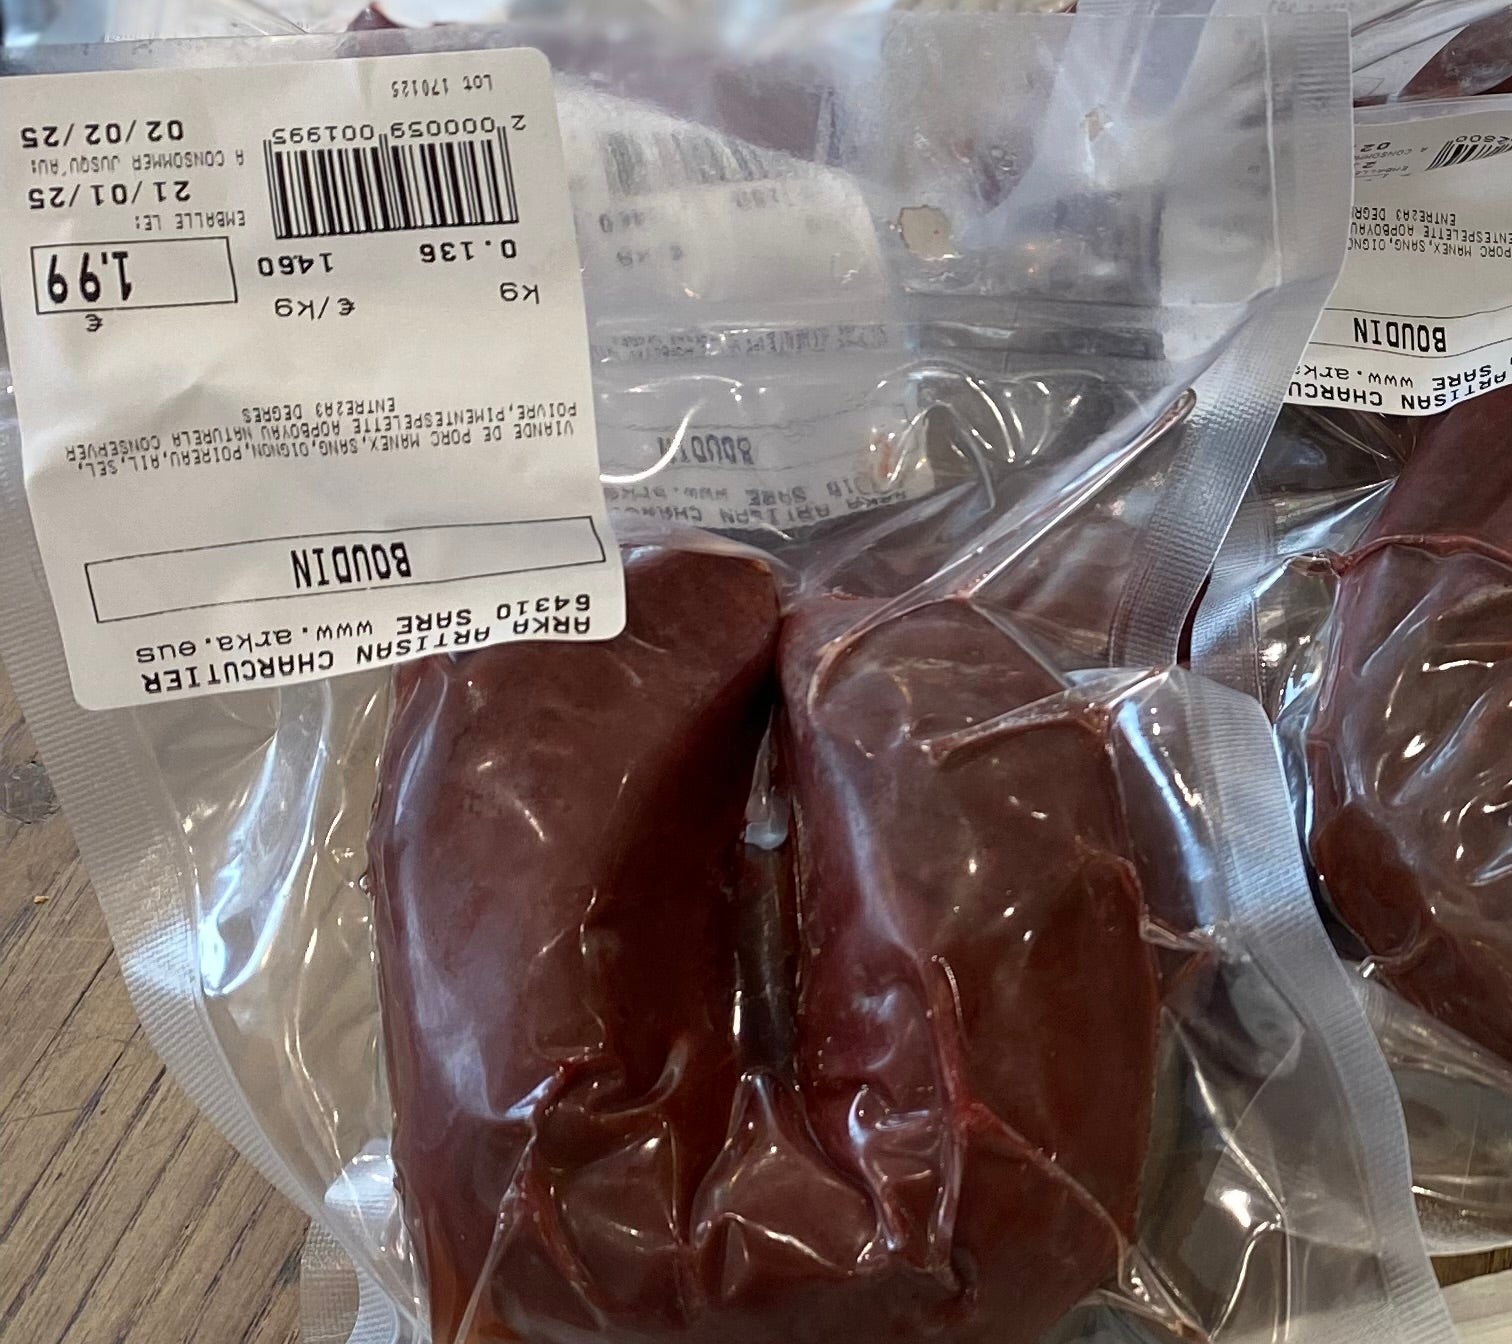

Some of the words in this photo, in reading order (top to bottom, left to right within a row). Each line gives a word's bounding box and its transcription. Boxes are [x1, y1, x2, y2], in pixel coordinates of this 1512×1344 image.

[390, 77, 449, 97] 170125
[463, 74, 492, 93] Lot
[20, 118, 184, 148] 02/02/25
[271, 124, 375, 144] 001995
[389, 117, 495, 140] 000059
[511, 114, 525, 131] 2
[131, 150, 224, 171] CONSOMMER
[234, 149, 244, 167] A
[26, 179, 191, 210] 21/01/25
[133, 213, 162, 232] LE:
[175, 209, 246, 230] EMBALLE
[1352, 206, 1385, 221] DEGR
[419, 238, 517, 264] 0.136
[1479, 245, 1511, 257] PORC
[46, 249, 133, 304] 1.99
[499, 282, 540, 305] kg
[273, 295, 356, 319] €/kg
[84, 314, 103, 333] €
[1353, 317, 1447, 352] BOUDIN
[1295, 364, 1413, 388] www.ark
[1431, 365, 1491, 390] SARE
[1288, 381, 1382, 406] CHARCU
[1401, 371, 1506, 410] ARTISAN
[241, 403, 302, 424] DEGRES
[429, 428, 471, 446] PORC
[484, 425, 502, 442] DE
[513, 420, 574, 440] VIANDE
[65, 435, 160, 462] CONSERVER
[290, 542, 412, 589] BOUDIN
[496, 594, 590, 619] 64310
[396, 609, 472, 635] SARE
[513, 615, 590, 635] ARKA
[135, 619, 372, 665] www.arka.eus
[356, 626, 490, 663] ARTISAN
[140, 650, 334, 693] CHARCUTIER
